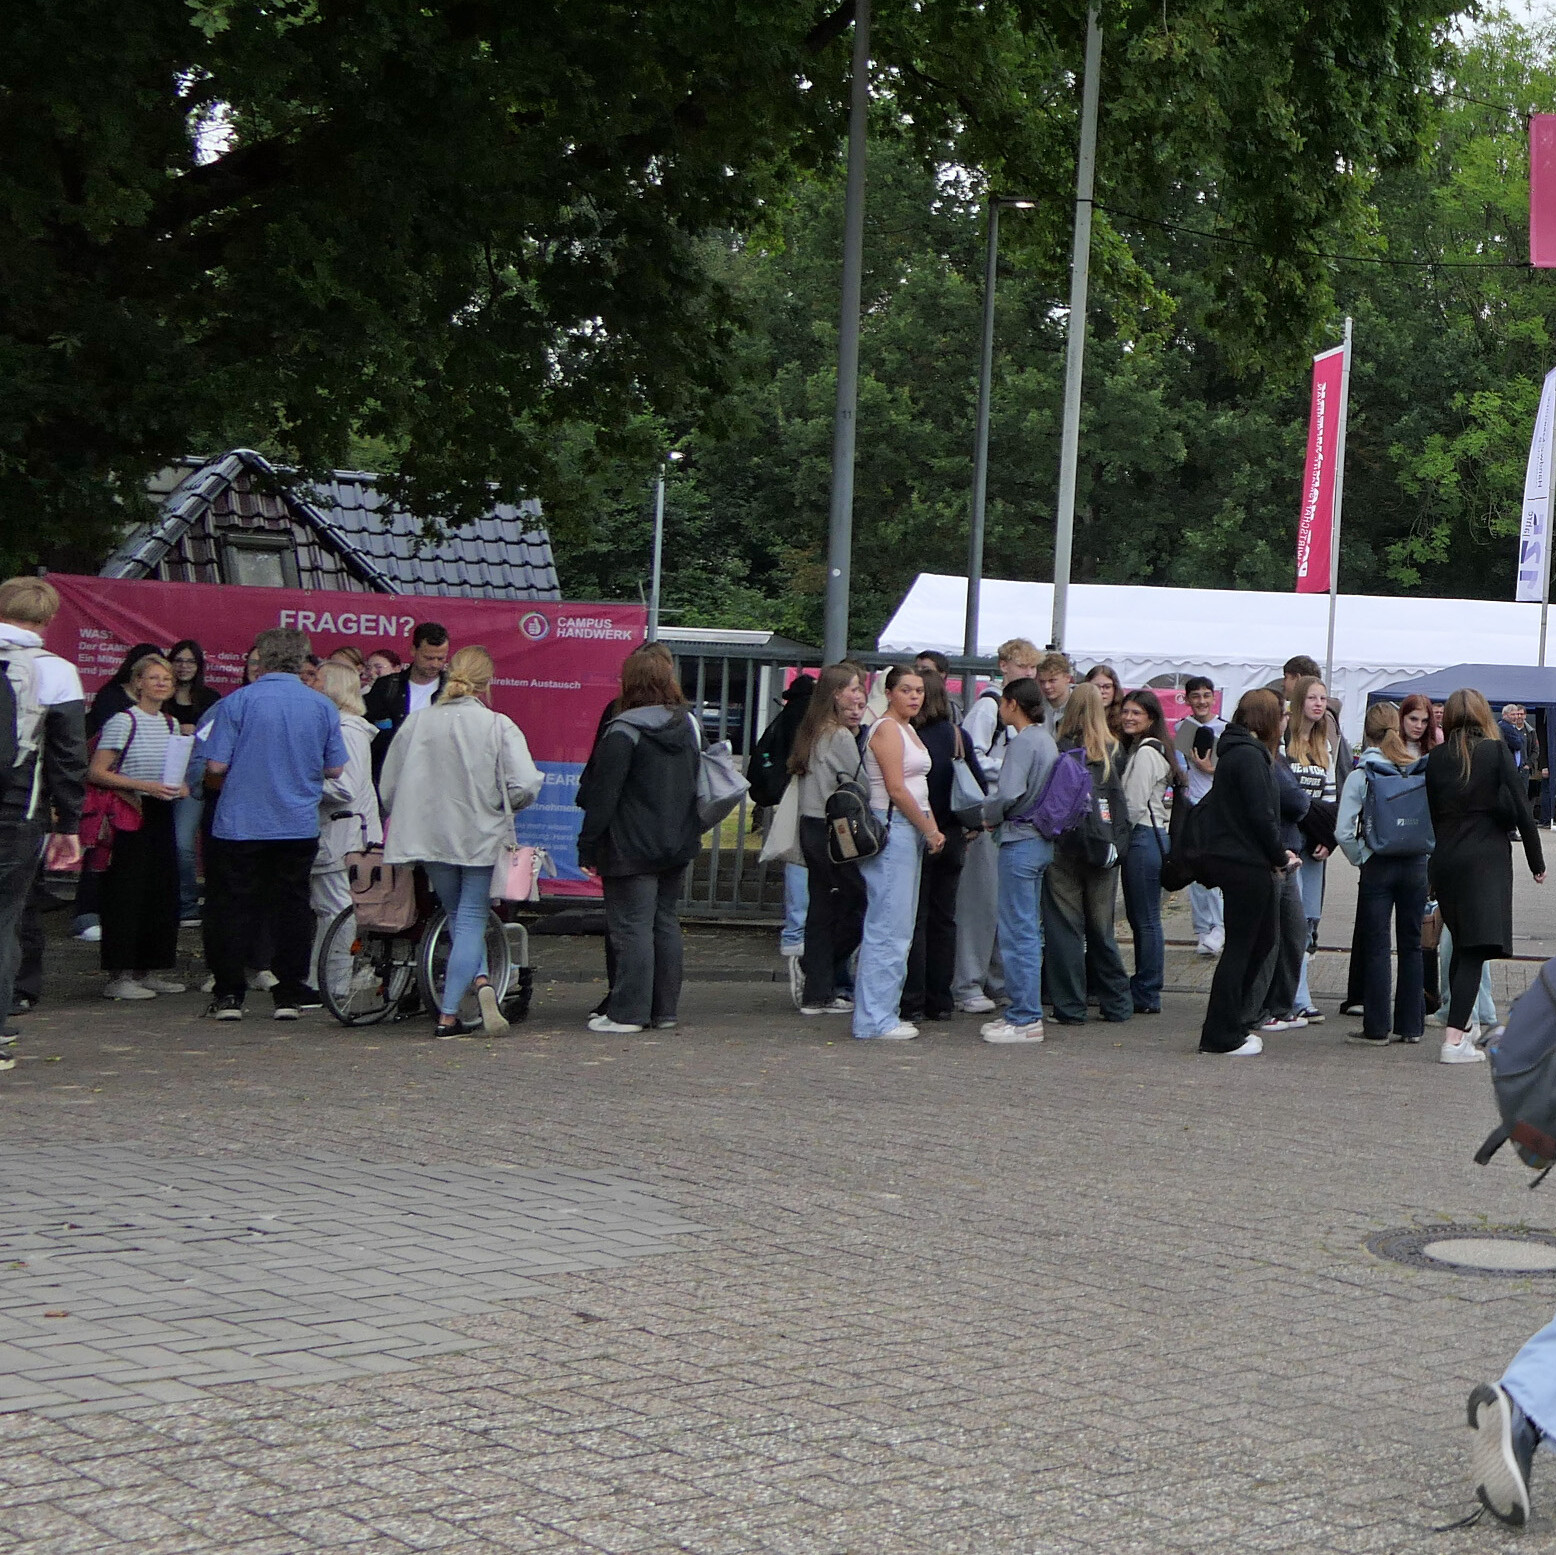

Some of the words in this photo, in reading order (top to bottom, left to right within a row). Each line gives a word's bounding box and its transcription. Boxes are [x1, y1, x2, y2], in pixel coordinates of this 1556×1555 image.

[280, 610, 415, 637] FRAGEN?
[557, 617, 612, 629] CAMPUS
[79, 628, 113, 639] WAS?
[556, 628, 632, 640] HANDWERK
[78, 653, 94, 662] Ein
[530, 679, 582, 689] Austausch
[543, 773, 581, 786] EAR
